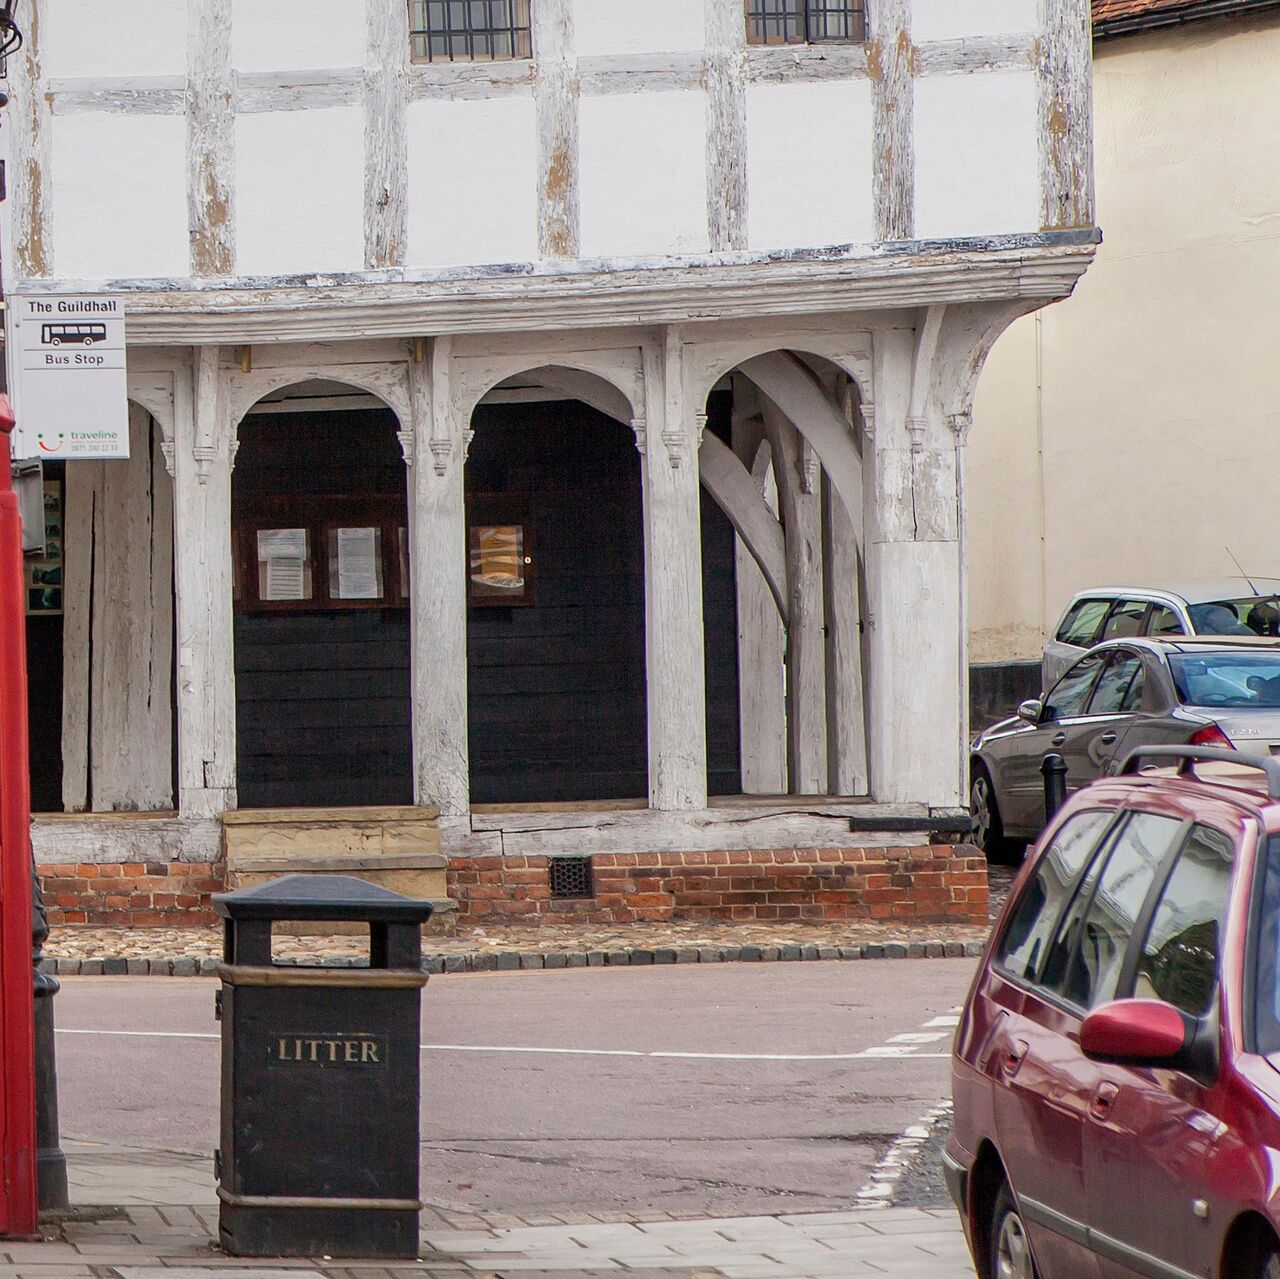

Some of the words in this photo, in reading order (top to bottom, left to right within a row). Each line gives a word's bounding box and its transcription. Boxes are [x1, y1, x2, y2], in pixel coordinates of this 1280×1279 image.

[29, 301, 52, 312] The
[58, 300, 117, 312] Guildhall
[45, 354, 70, 365] Bus
[75, 354, 104, 366] Stop
[71, 430, 118, 440] traveline
[278, 1039, 380, 1062] LITTER
